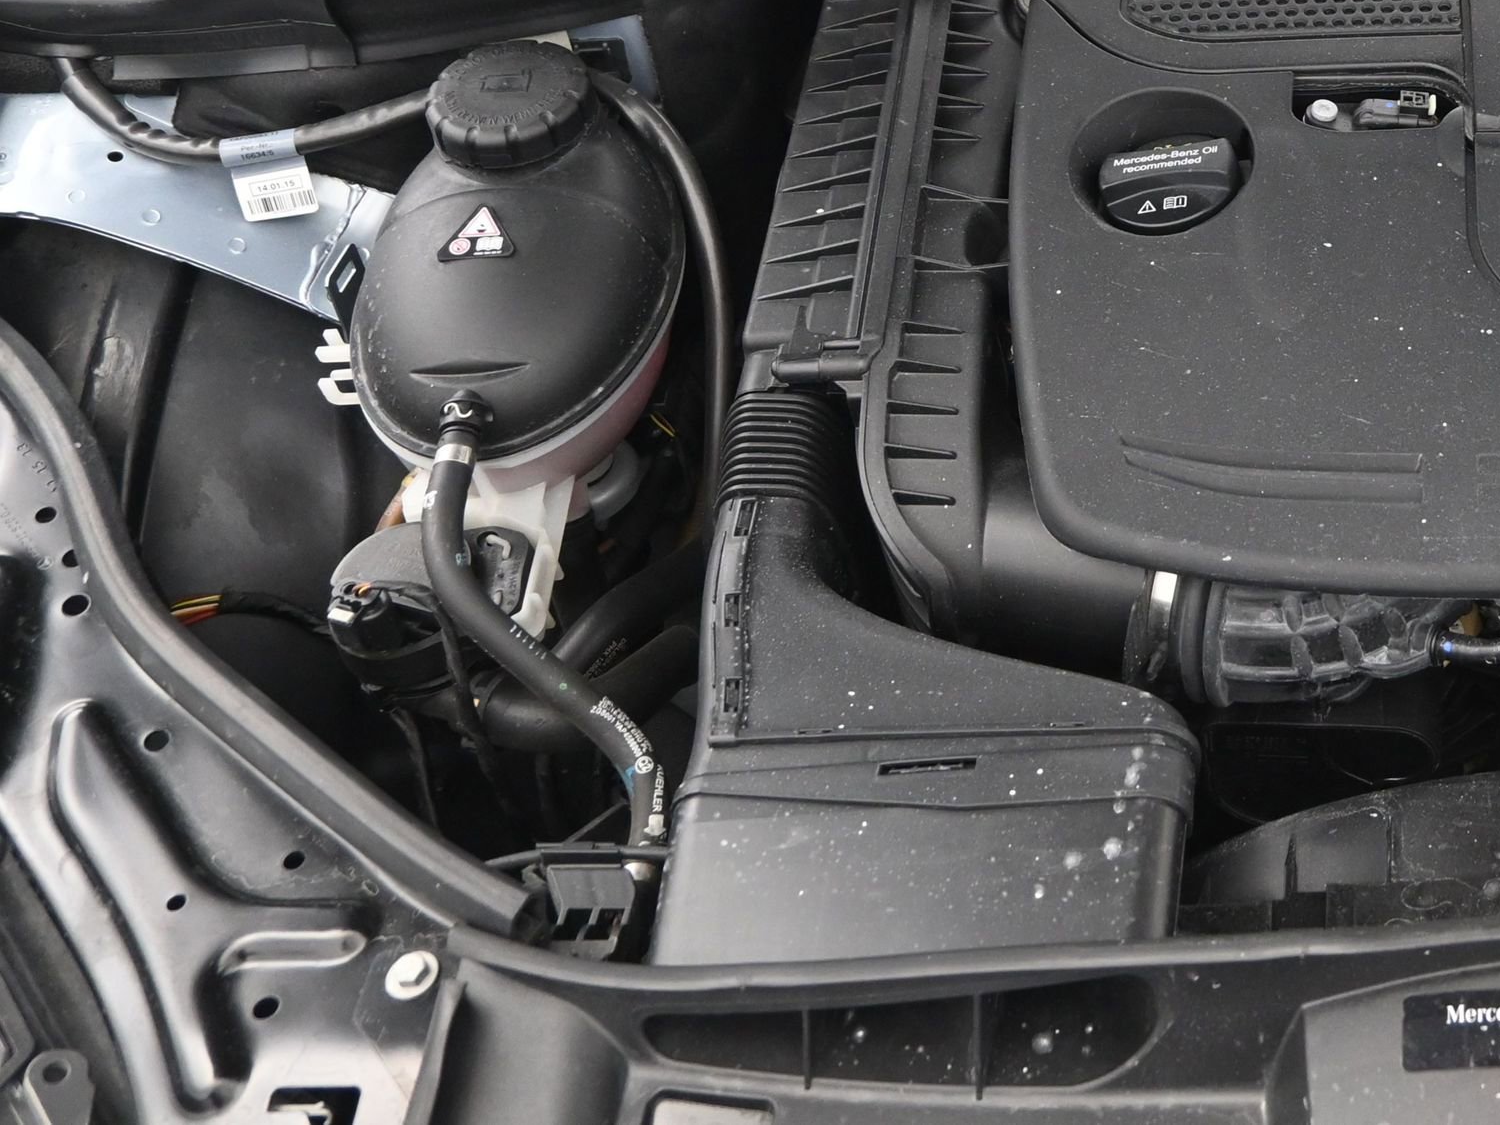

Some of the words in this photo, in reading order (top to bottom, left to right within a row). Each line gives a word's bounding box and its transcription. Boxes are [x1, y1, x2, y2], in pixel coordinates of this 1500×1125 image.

[1113, 149, 1200, 167] Mercedes-Benz
[1202, 145, 1218, 155] Oil
[1122, 156, 1202, 174] recommended
